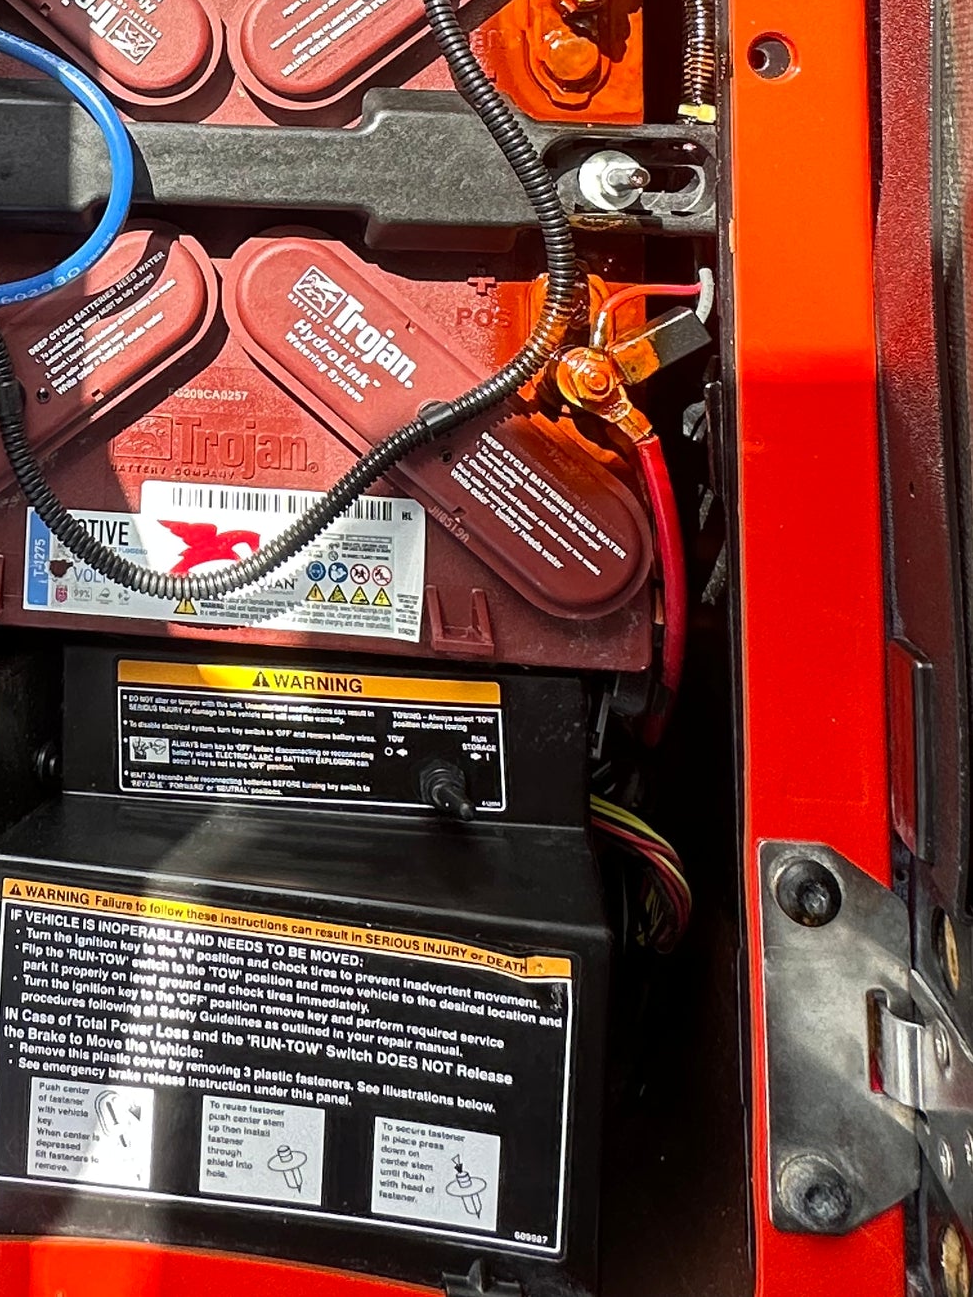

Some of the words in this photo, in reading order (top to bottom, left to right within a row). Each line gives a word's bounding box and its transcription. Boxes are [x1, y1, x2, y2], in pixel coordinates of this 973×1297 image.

[28, 338, 49, 356] DEEP
[49, 318, 75, 340] CYCLE
[74, 289, 116, 322] BATTERIES
[116, 271, 137, 290] NEED
[137, 251, 165, 274] WATER
[333, 294, 416, 383] Trojan
[457, 307, 512, 327] POS
[285, 331, 329, 373] Watering
[328, 369, 363, 402] System
[294, 319, 370, 388] HydroLink
[113, 464, 166, 475] BATTERY
[175, 468, 234, 480] COMPANY
[175, 414, 308, 478] Trojan
[481, 431, 504, 451] DEEP
[503, 450, 529, 475] CYCLE
[528, 473, 575, 514] BATTERIES
[572, 510, 597, 533] NEED
[596, 530, 627, 560] WATER
[495, 507, 520, 533] battery
[519, 531, 543, 552] needs
[542, 549, 564, 569] water
[274, 672, 363, 694] WARNING
[9, 909, 22, 921] IF
[24, 910, 80, 928] VEHICLE
[81, 918, 95, 930] IS
[97, 920, 184, 943] INOPERABLE
[185, 931, 215, 947] AND
[216, 936, 263, 953] NEEDS
[265, 943, 285, 956] TO
[287, 946, 307, 959] BE
[309, 949, 364, 966] MOVED:
[24, 885, 90, 904] WARNING
[94, 895, 133, 910] Failure
[134, 900, 147, 912] to
[149, 902, 184, 917] follow
[185, 907, 218, 922] these
[219, 913, 288, 932] instructions
[290, 925, 312, 935] can
[314, 927, 348, 940] result
[350, 931, 362, 942] in
[364, 933, 420, 950] SERIOUS
[422, 940, 468, 958] INJURY
[469, 950, 483, 961] or
[485, 953, 529, 973] DEATH
[21, 942, 43, 956] Flip
[44, 946, 64, 957] the
[65, 948, 128, 965] 'RUN-TOW'
[131, 956, 170, 971] switch
[171, 961, 185, 972] to
[185, 962, 206, 975] the
[207, 965, 242, 979] 'TOW'
[244, 970, 293, 990] position
[295, 979, 318, 991] and
[320, 983, 354, 996] move
[356, 987, 399, 1002] vehicle
[401, 993, 414, 1004] to
[416, 996, 437, 1007] the
[438, 1000, 485, 1015] desired
[486, 1007, 537, 1023] location
[538, 1015, 563, 1027] and
[25, 927, 52, 940] Turn
[53, 931, 72, 943] the
[73, 935, 117, 950] ignition
[119, 940, 140, 953] key
[142, 942, 156, 954] to
[156, 944, 177, 957] the
[178, 946, 194, 959] 'N'
[196, 949, 245, 966] position
[246, 956, 269, 969] and
[271, 960, 308, 974] chock
[309, 966, 337, 978] tires
[339, 970, 353, 980] to
[354, 972, 400, 989] prevent
[402, 979, 471, 997] inadvertent
[473, 988, 541, 1010] movement.
[3, 1025, 25, 1038] the
[27, 1028, 66, 1043] Brake
[68, 1033, 83, 1044] to
[85, 1034, 122, 1049] Move
[124, 1038, 147, 1053] the
[149, 1041, 204, 1058] Vehicle:
[4, 1008, 19, 1020] IN
[21, 1010, 55, 1024] Case
[57, 1014, 71, 1026] of
[74, 1016, 107, 1030] Total
[110, 1020, 153, 1036] Power
[155, 1025, 189, 1040] Loss
[192, 1030, 218, 1042] and
[221, 1032, 244, 1045] the
[246, 1034, 322, 1055] 'RUN-TOW'
[325, 1046, 373, 1062] Switch
[376, 1052, 418, 1069] DOES
[421, 1058, 452, 1074] NOT
[455, 1065, 513, 1084] Release
